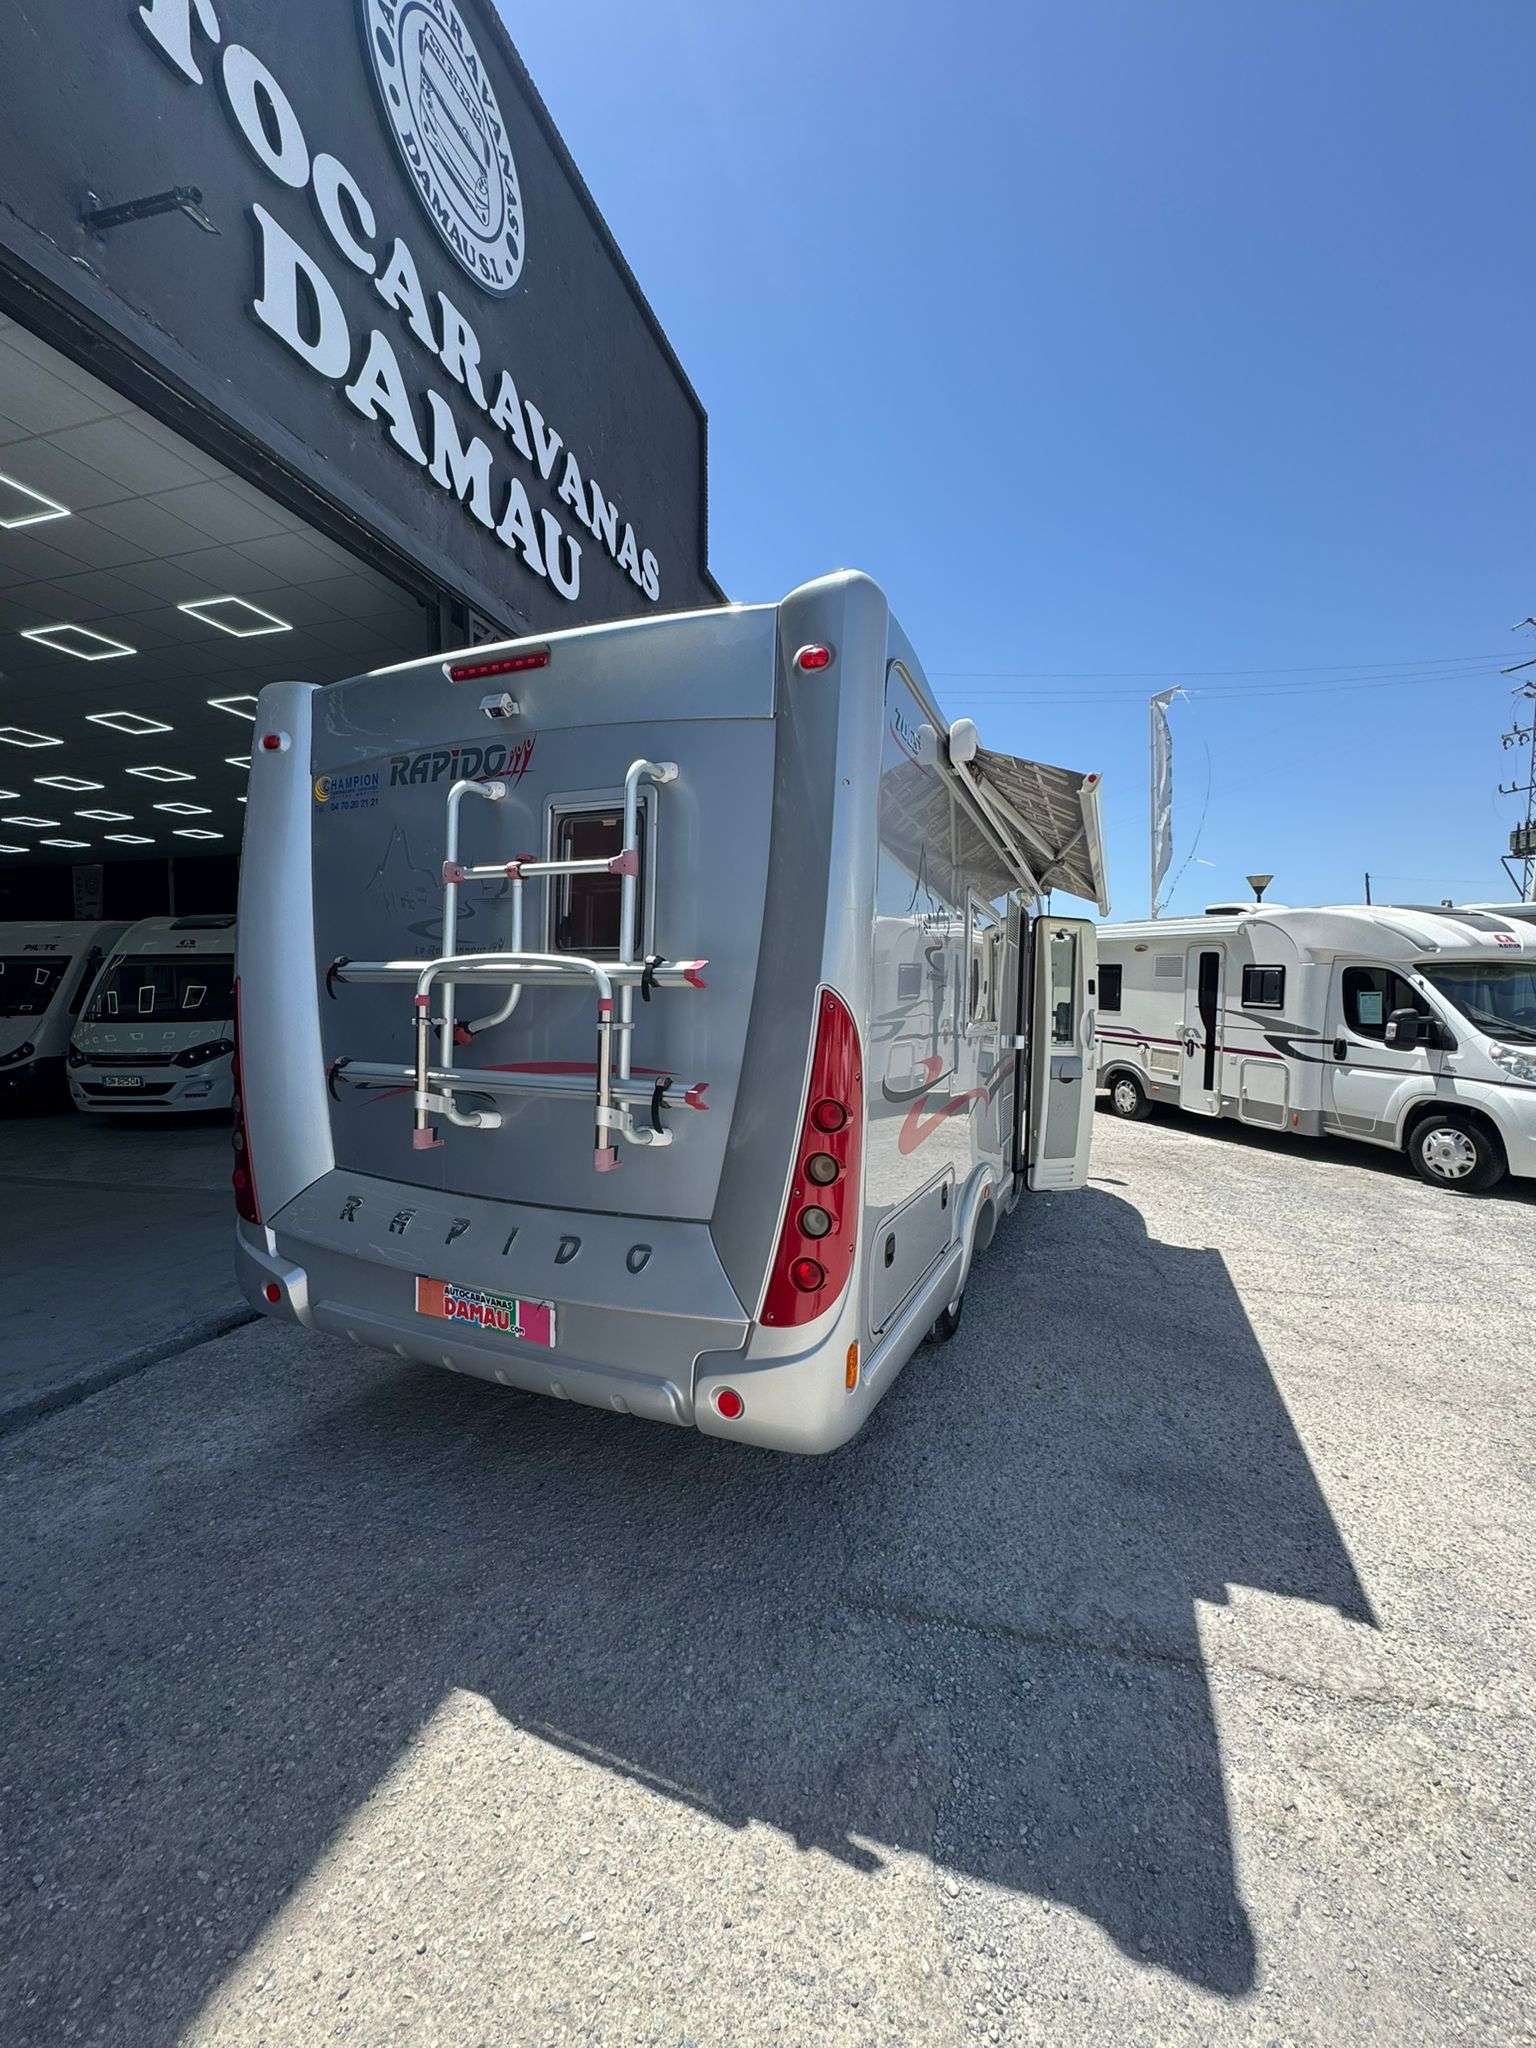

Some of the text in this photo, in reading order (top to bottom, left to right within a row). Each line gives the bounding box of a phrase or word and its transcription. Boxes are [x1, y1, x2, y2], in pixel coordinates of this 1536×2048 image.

[401, 129, 478, 269] DAMAU
[253, 202, 583, 601] DAMAU
[321, 772, 380, 793] CHAMPION
[390, 743, 507, 787] RAPIDO
[339, 1195, 654, 1275] RAPIDO
[443, 1285, 513, 1310] AUTOCARAVANAS
[443, 1297, 511, 1331] DAMAU
